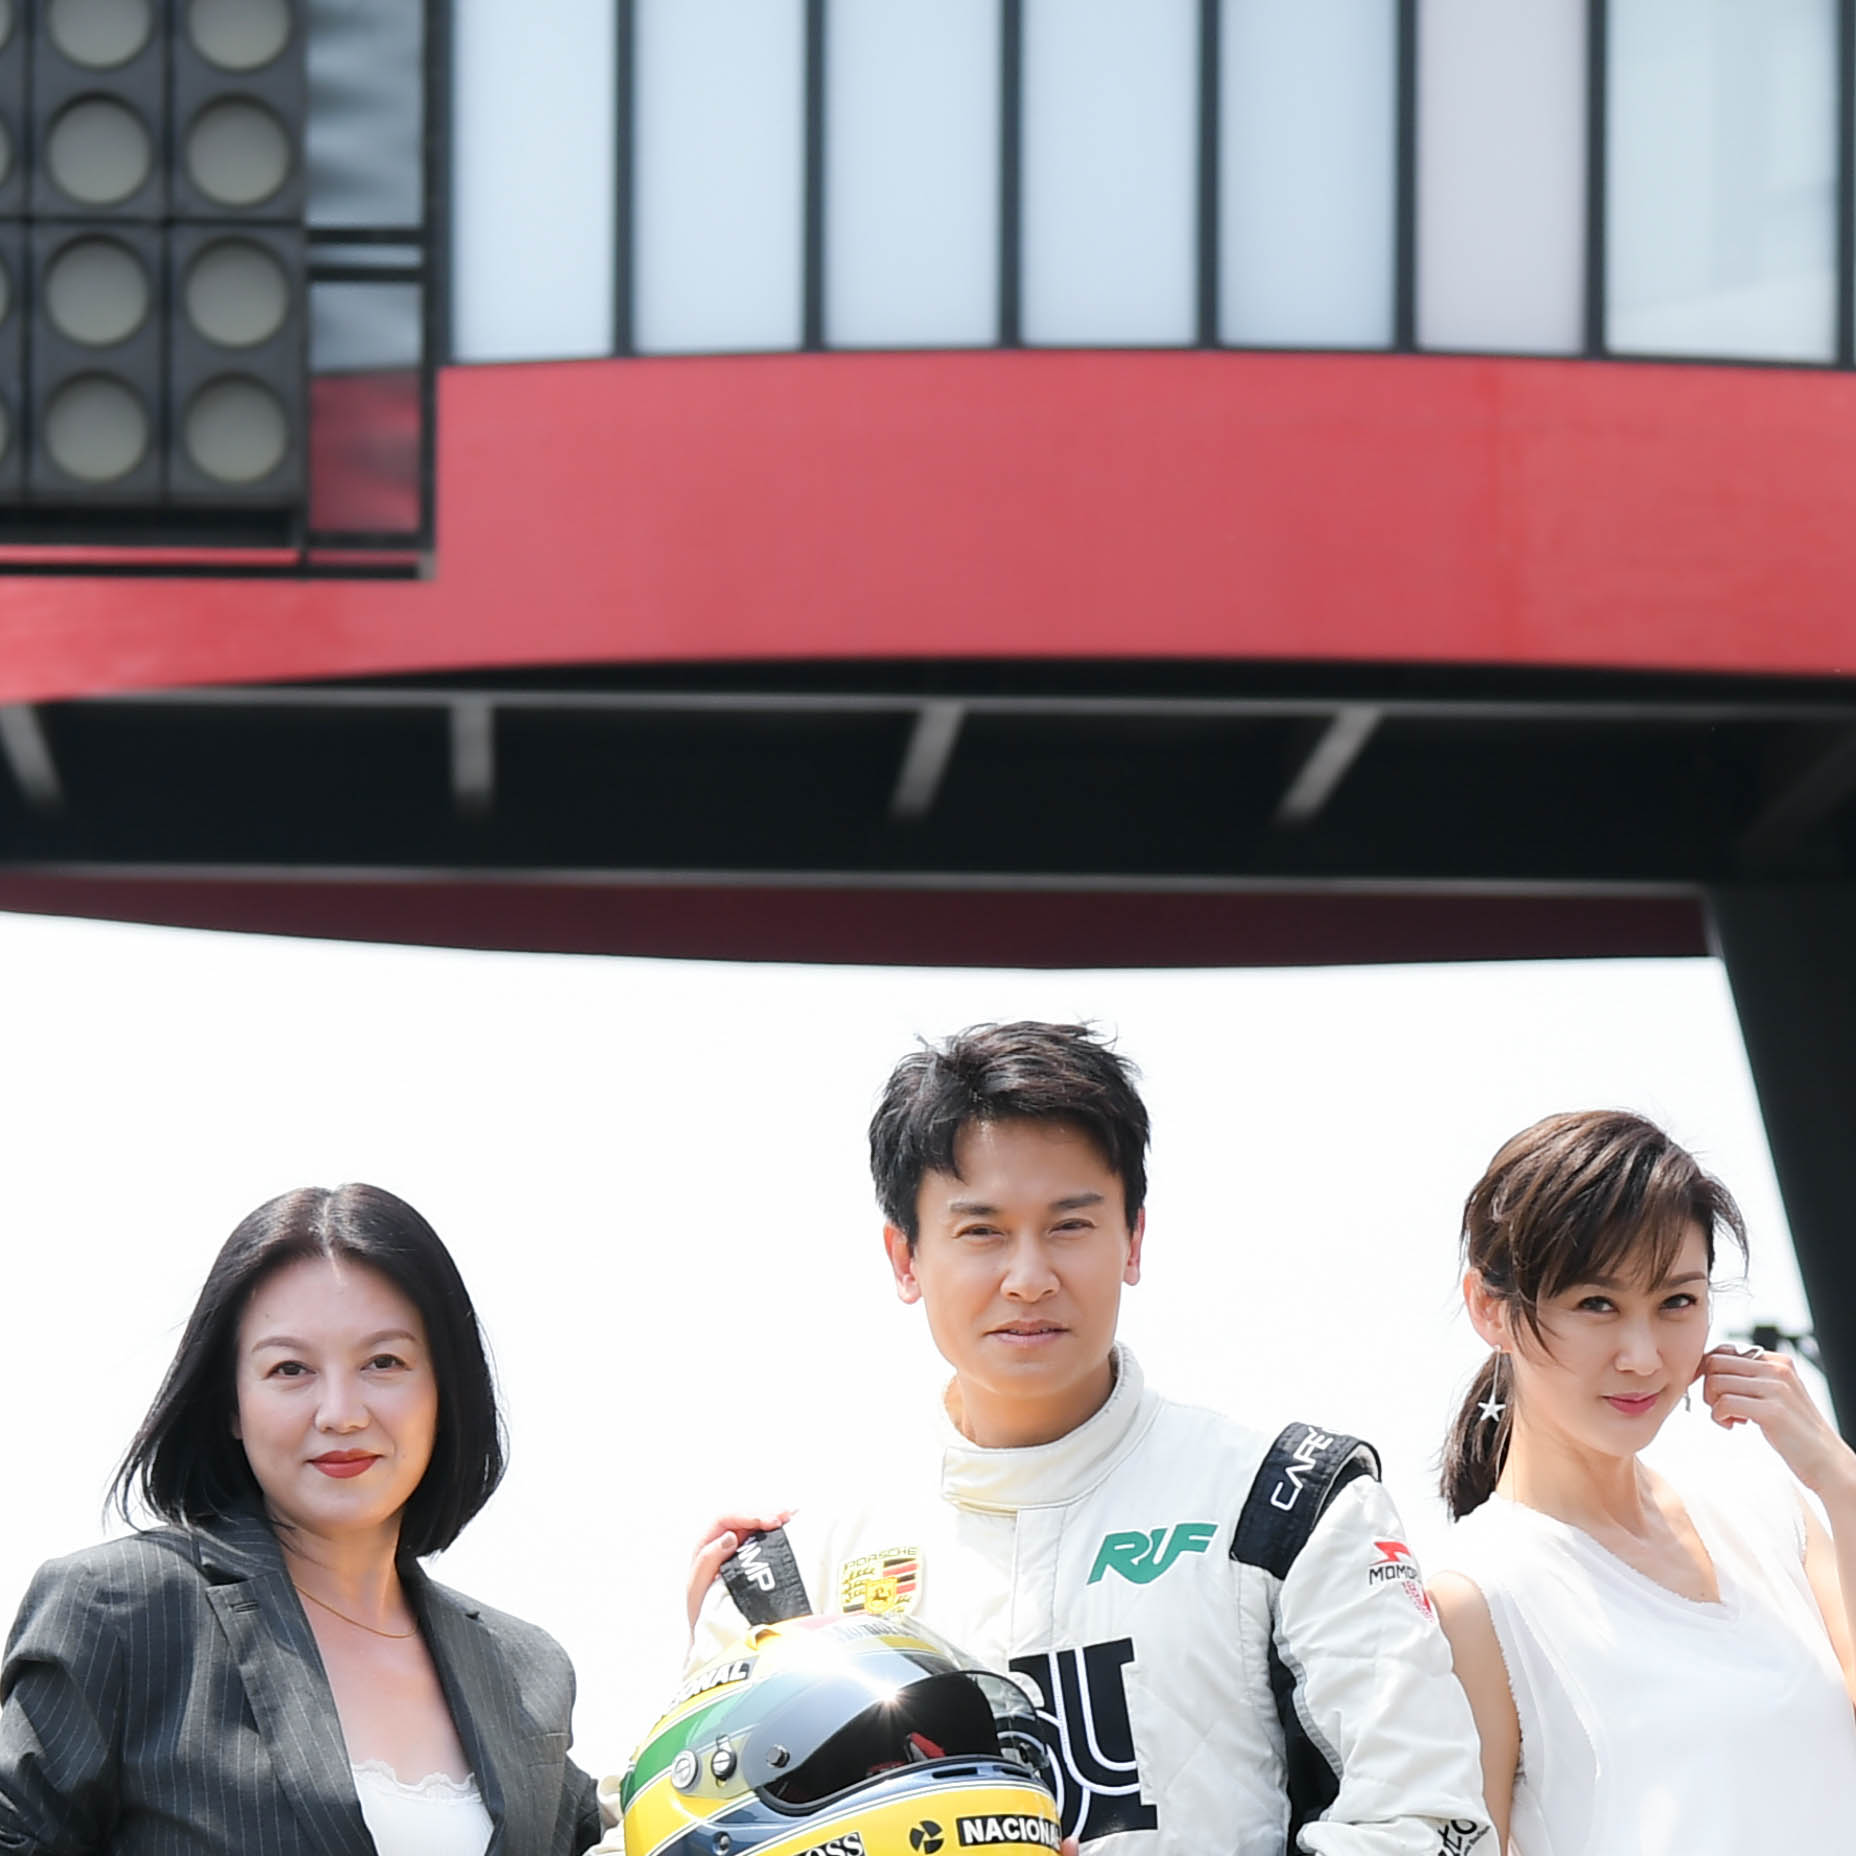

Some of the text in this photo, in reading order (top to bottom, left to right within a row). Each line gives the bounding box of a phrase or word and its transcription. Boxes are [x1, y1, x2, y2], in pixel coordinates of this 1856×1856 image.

[736, 1536, 776, 1592] MP
[843, 1546, 918, 1572] PORSCHE
[1086, 1522, 1219, 1586] RUF
